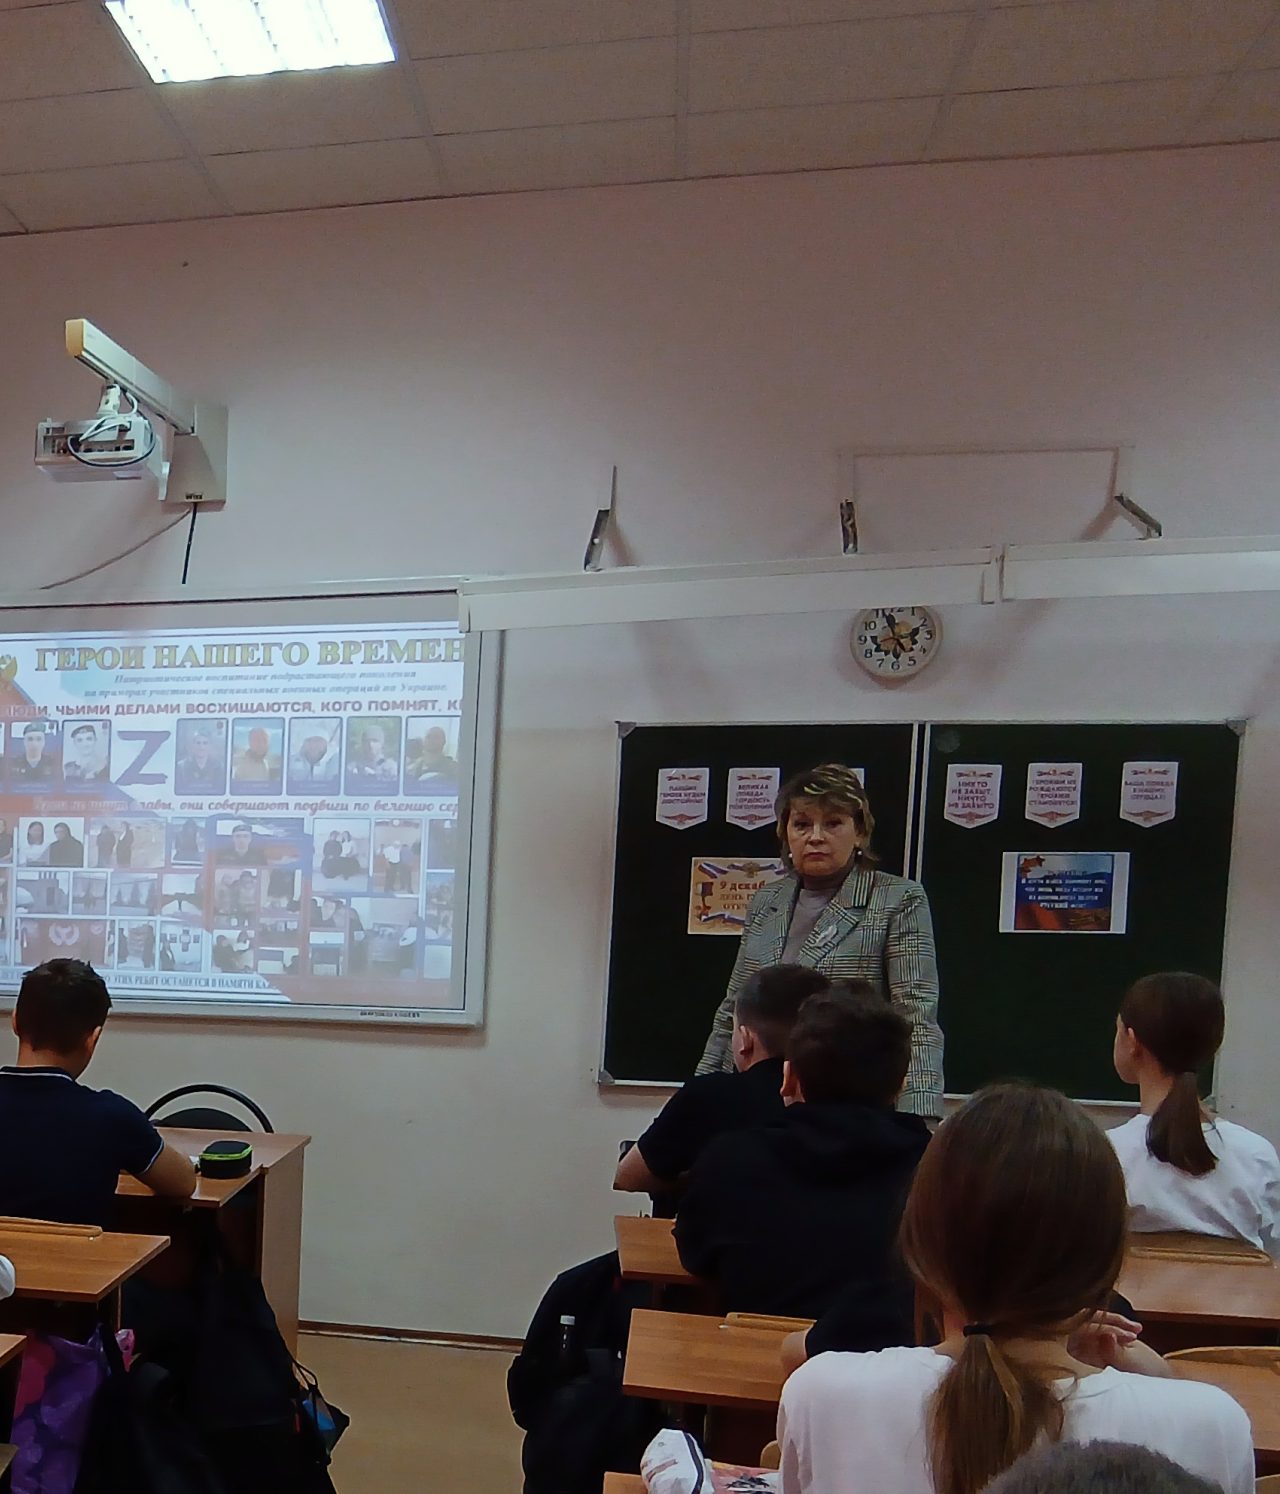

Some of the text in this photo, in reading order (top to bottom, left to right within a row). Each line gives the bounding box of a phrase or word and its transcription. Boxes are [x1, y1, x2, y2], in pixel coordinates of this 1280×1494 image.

[863, 620, 877, 631] 10
[858, 635, 867, 645] 9
[34, 646, 147, 671] ГЕРОИ
[152, 641, 310, 670] НАШЕГО
[864, 649, 873, 658] 8
[891, 660, 901, 671] 6
[907, 656, 917, 667] 5
[55, 704, 110, 716] ЧЬИМИ
[114, 702, 181, 716] ДЕЛАМИ
[185, 700, 316, 715] ВОСХИЩАЮТСЯ,
[320, 700, 363, 712] КОГО
[179, 802, 204, 811] они
[208, 801, 289, 816] совершают
[293, 800, 349, 816] подвиги
[353, 801, 370, 811] по
[720, 881, 727, 890] 9
